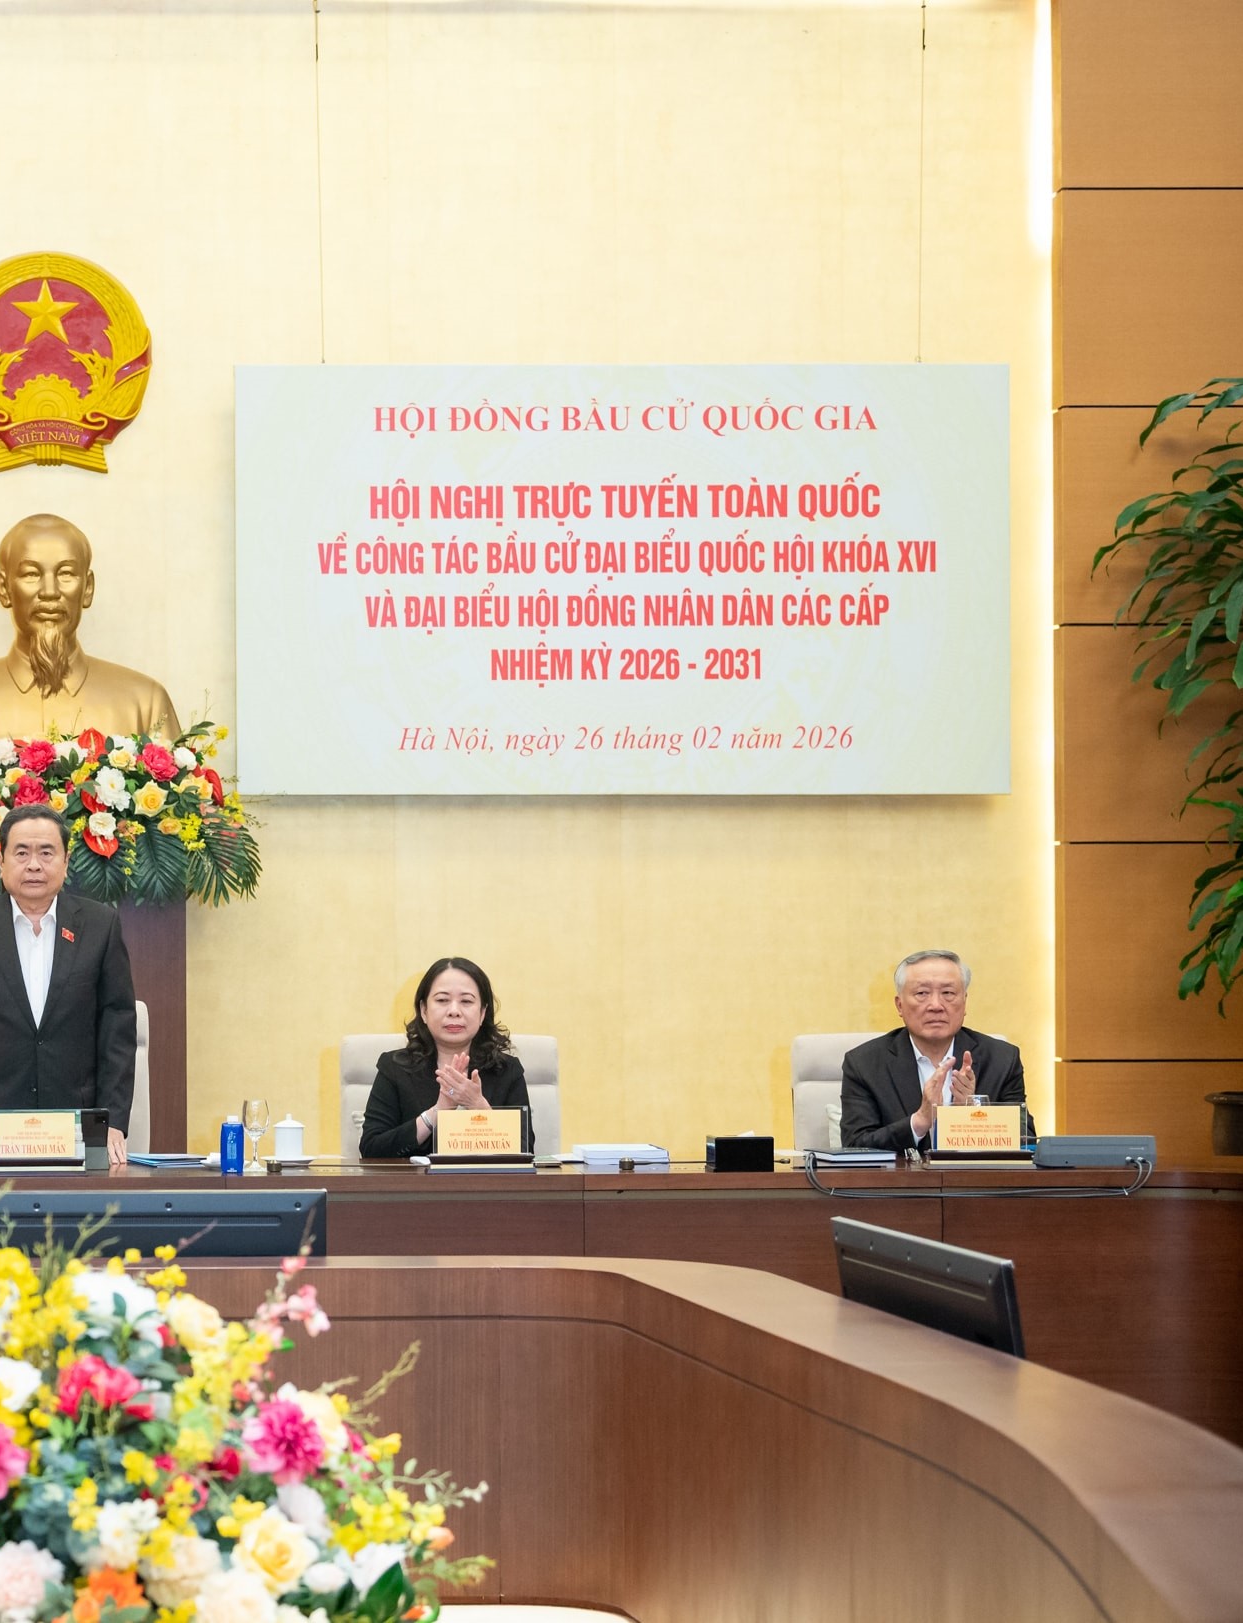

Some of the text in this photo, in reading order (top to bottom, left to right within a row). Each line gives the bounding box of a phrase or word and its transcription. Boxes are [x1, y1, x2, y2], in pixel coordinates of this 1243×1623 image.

[374, 397, 878, 439] HỘI ĐỒNG BẦU CỬ QUỐC GIA
[48, 431, 81, 444] NAM
[369, 471, 881, 527] HỘI NGHỊ TRỰC TUYẾN TOÀN QUỐC
[317, 528, 937, 581] VỀ CÔNG TÁC BẦU CỬ ĐẠI BIỂU QUỐC HỘI KHÓA XVI
[364, 582, 890, 635] VÀ ĐẠI BIỂU HỘI ĐỒNG NHÂN DÂN CÁC CẤP
[490, 641, 762, 688] NHIỆM KỲ 2026 - 2031
[398, 725, 855, 756] Hà Nội, ngày 26 tháng 02 năm 2026
[21, 1144, 48, 1154] THANH
[460, 1140, 473, 1151] THỊ
[977, 1134, 993, 1147] HÒA
